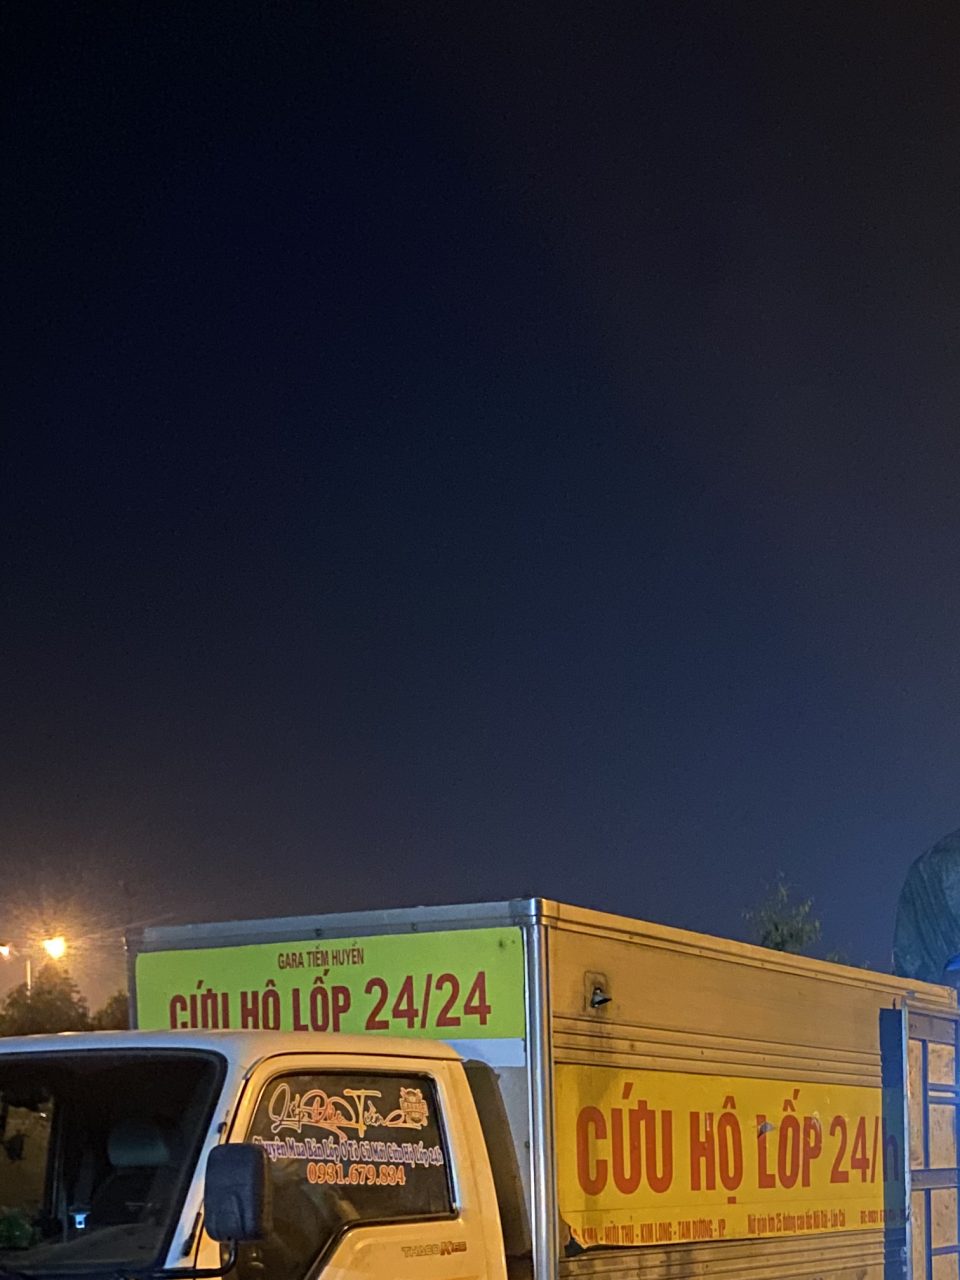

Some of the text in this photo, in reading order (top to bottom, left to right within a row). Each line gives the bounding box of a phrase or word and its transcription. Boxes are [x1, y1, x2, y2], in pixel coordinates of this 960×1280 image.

[278, 952, 304, 969] GARA
[170, 980, 229, 1029] CỨU
[292, 969, 351, 1032] LỐP
[365, 971, 491, 1031] 24/24
[576, 1082, 673, 1196] CỨU
[690, 1095, 743, 1204] HỘ
[756, 1089, 823, 1189] LỐP
[307, 1162, 406, 1185] 0931.679.834
[655, 1221, 672, 1242] LONG
